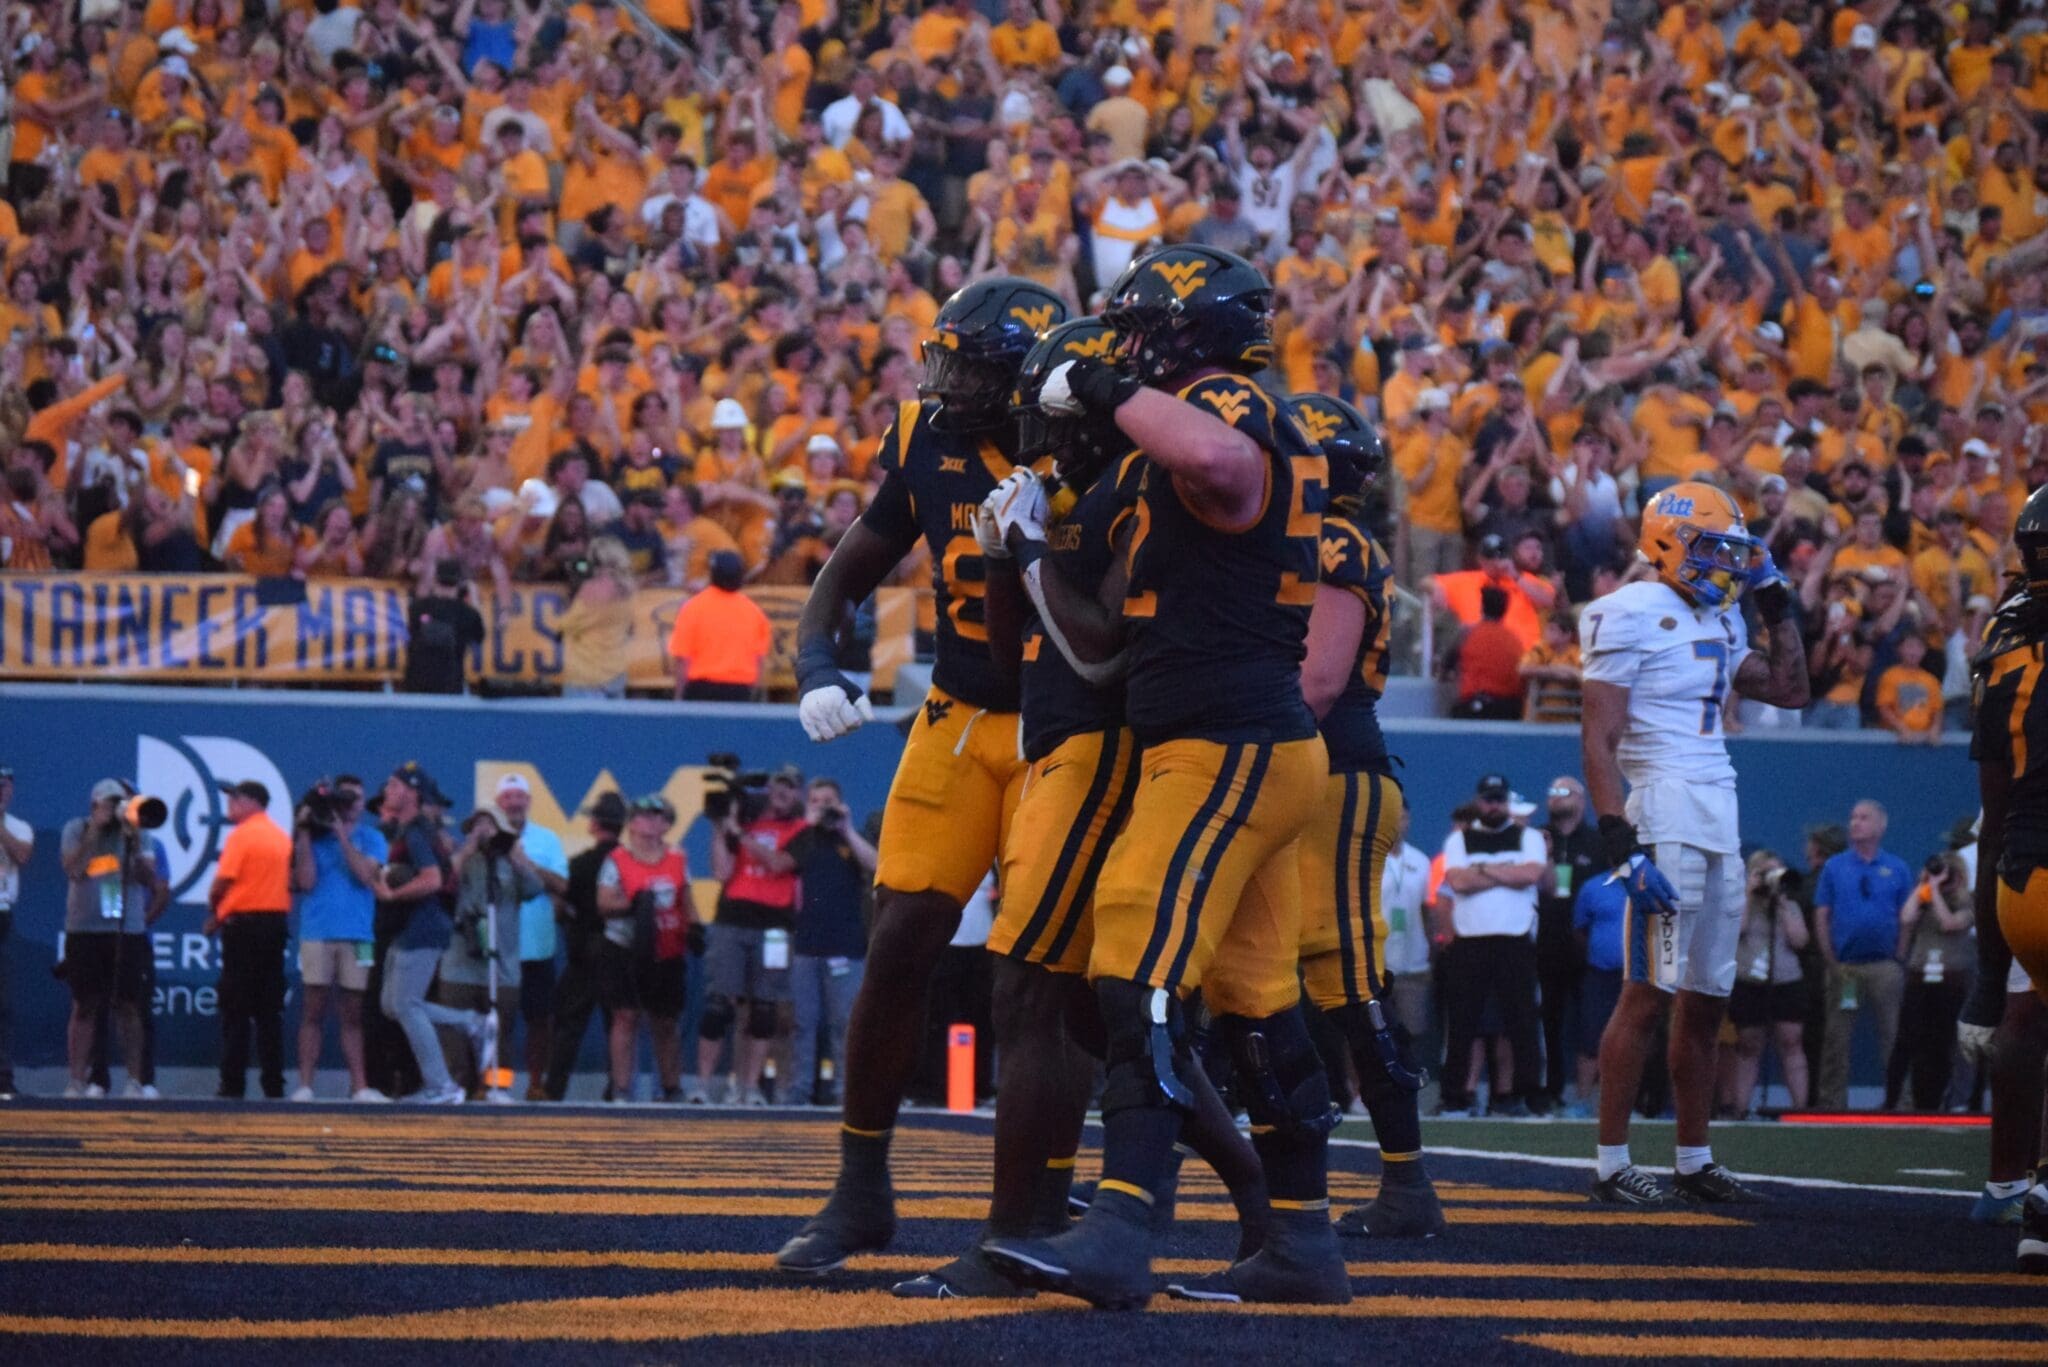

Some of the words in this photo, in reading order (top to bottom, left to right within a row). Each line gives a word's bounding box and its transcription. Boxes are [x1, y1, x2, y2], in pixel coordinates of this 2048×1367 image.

[1656, 493, 1696, 518] Pitt
[0, 581, 268, 668] TAINEER
[295, 587, 564, 674] MANCS
[1590, 614, 1604, 646] 7
[1692, 641, 1730, 736] 7
[1986, 640, 2046, 780] 7
